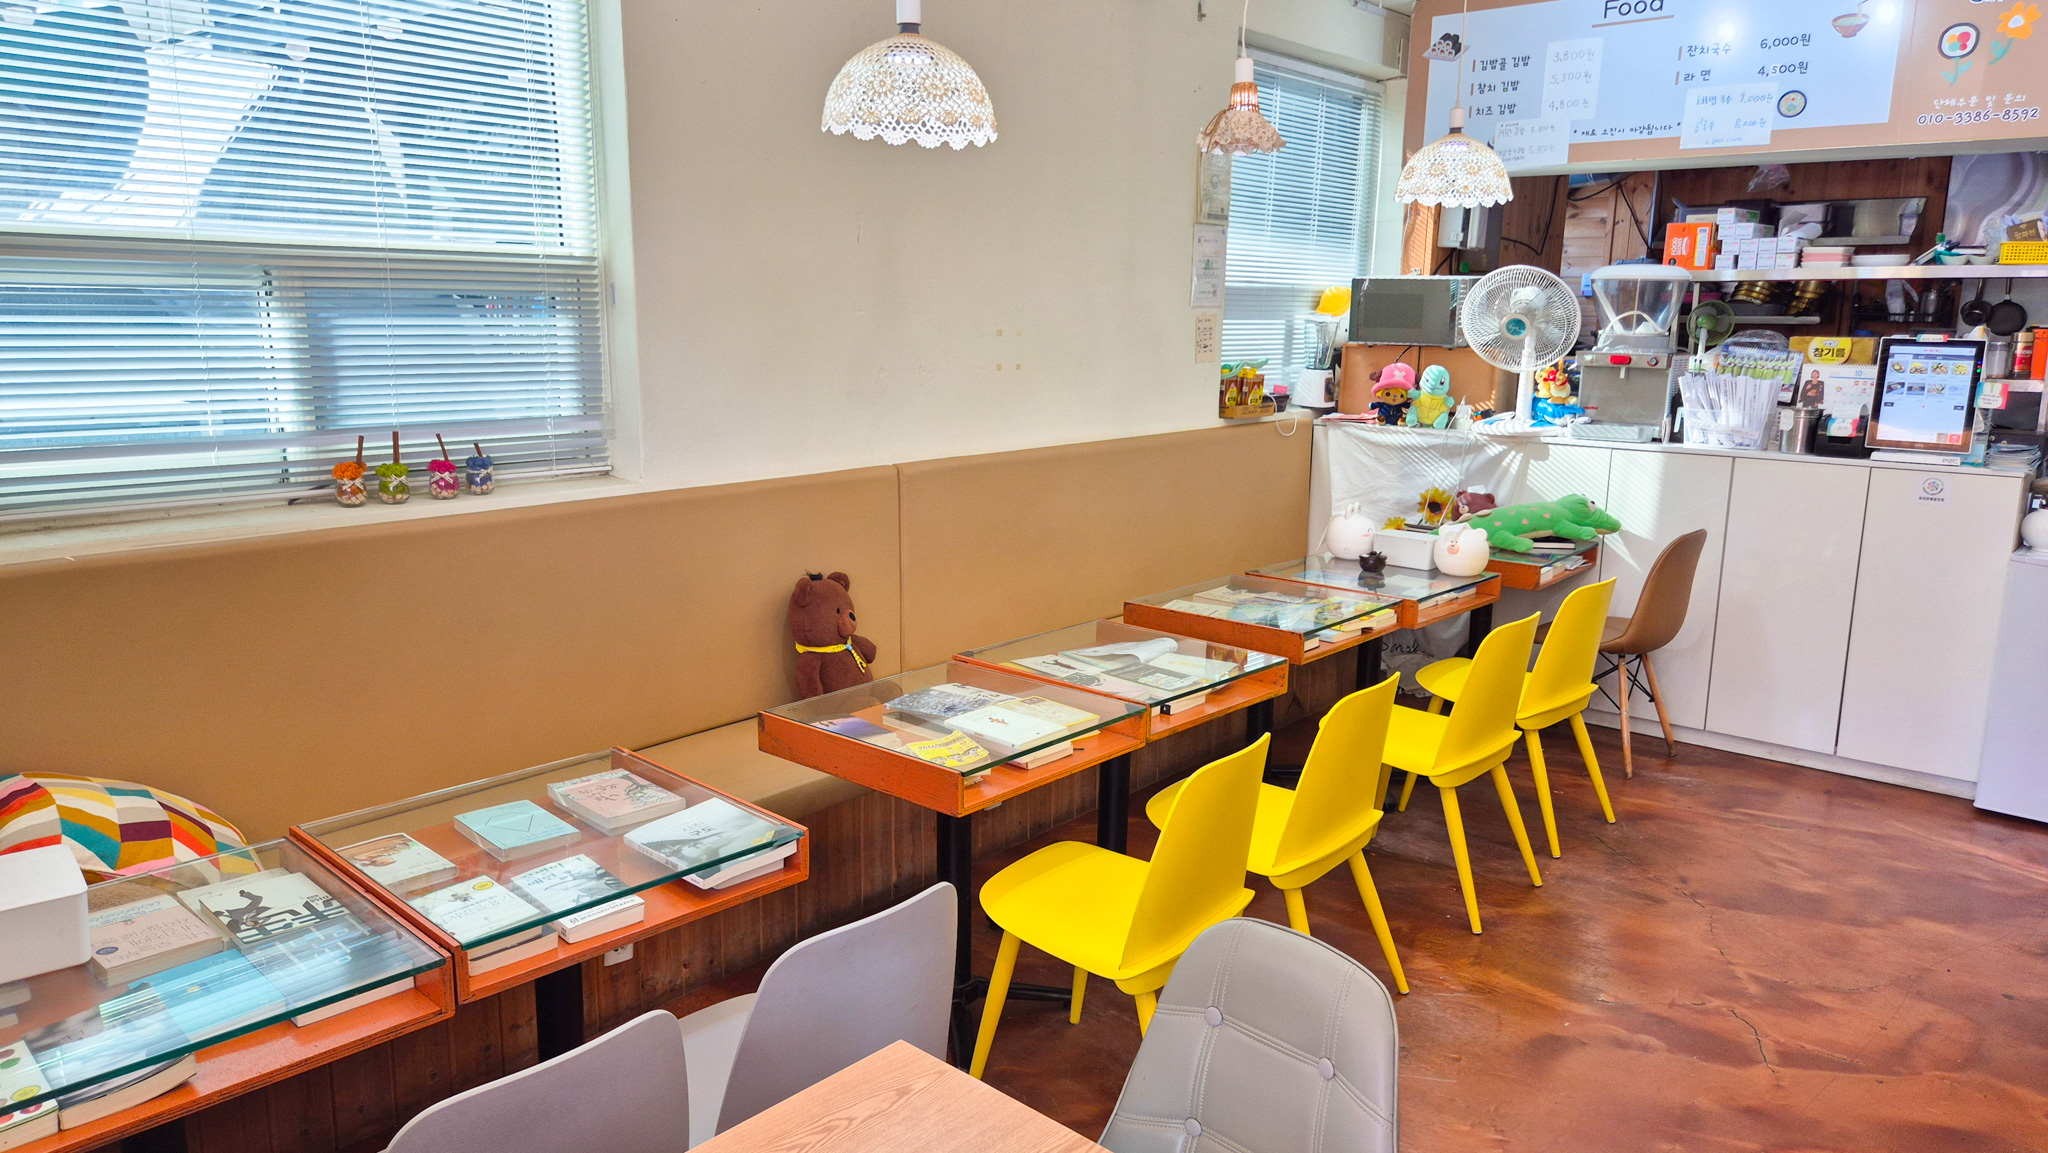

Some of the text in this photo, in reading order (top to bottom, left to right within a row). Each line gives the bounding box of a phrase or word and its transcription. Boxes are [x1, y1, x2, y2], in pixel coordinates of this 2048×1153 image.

[1603, 0, 1664, 19] Food
[1686, 33, 1811, 57] 잔치국수 6,000원
[1480, 55, 1531, 71] 김밥골 김밥
[1552, 48, 1596, 63] 3,800원
[1757, 61, 1809, 78] 4,500원
[1477, 79, 1520, 95] 참치 김밥
[1985, 95, 1996, 108] 및
[2003, 92, 2026, 104] 문의
[1475, 103, 1517, 116] 치즈 김밥
[1917, 107, 2040, 126] 010-3386-8592
[1629, 124, 1673, 136] 마감됩니다
[1813, 347, 1846, 358] 참기름
